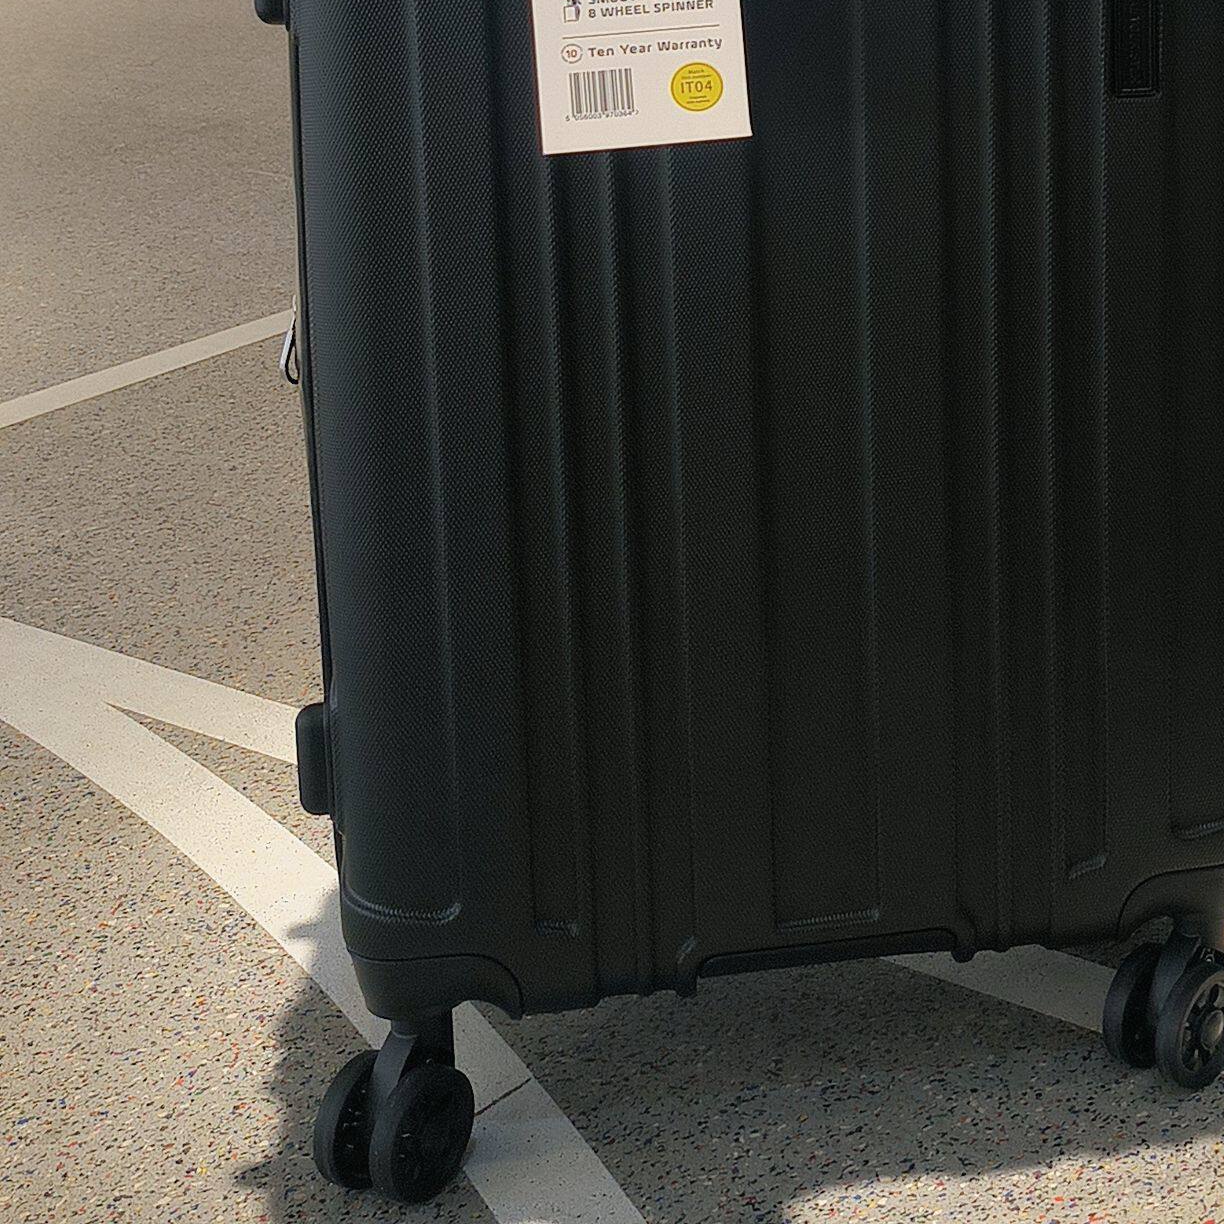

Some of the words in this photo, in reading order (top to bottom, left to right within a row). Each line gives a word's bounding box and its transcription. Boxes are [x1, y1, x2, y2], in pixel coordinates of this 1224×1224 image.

[588, 8, 596, 18] 8
[600, 4, 650, 17] WHEEL
[654, 0, 714, 13] SPINNER
[588, 47, 615, 58] Ten
[619, 44, 652, 55] Year
[657, 38, 723, 52] Warranty
[680, 80, 713, 94] IT04
